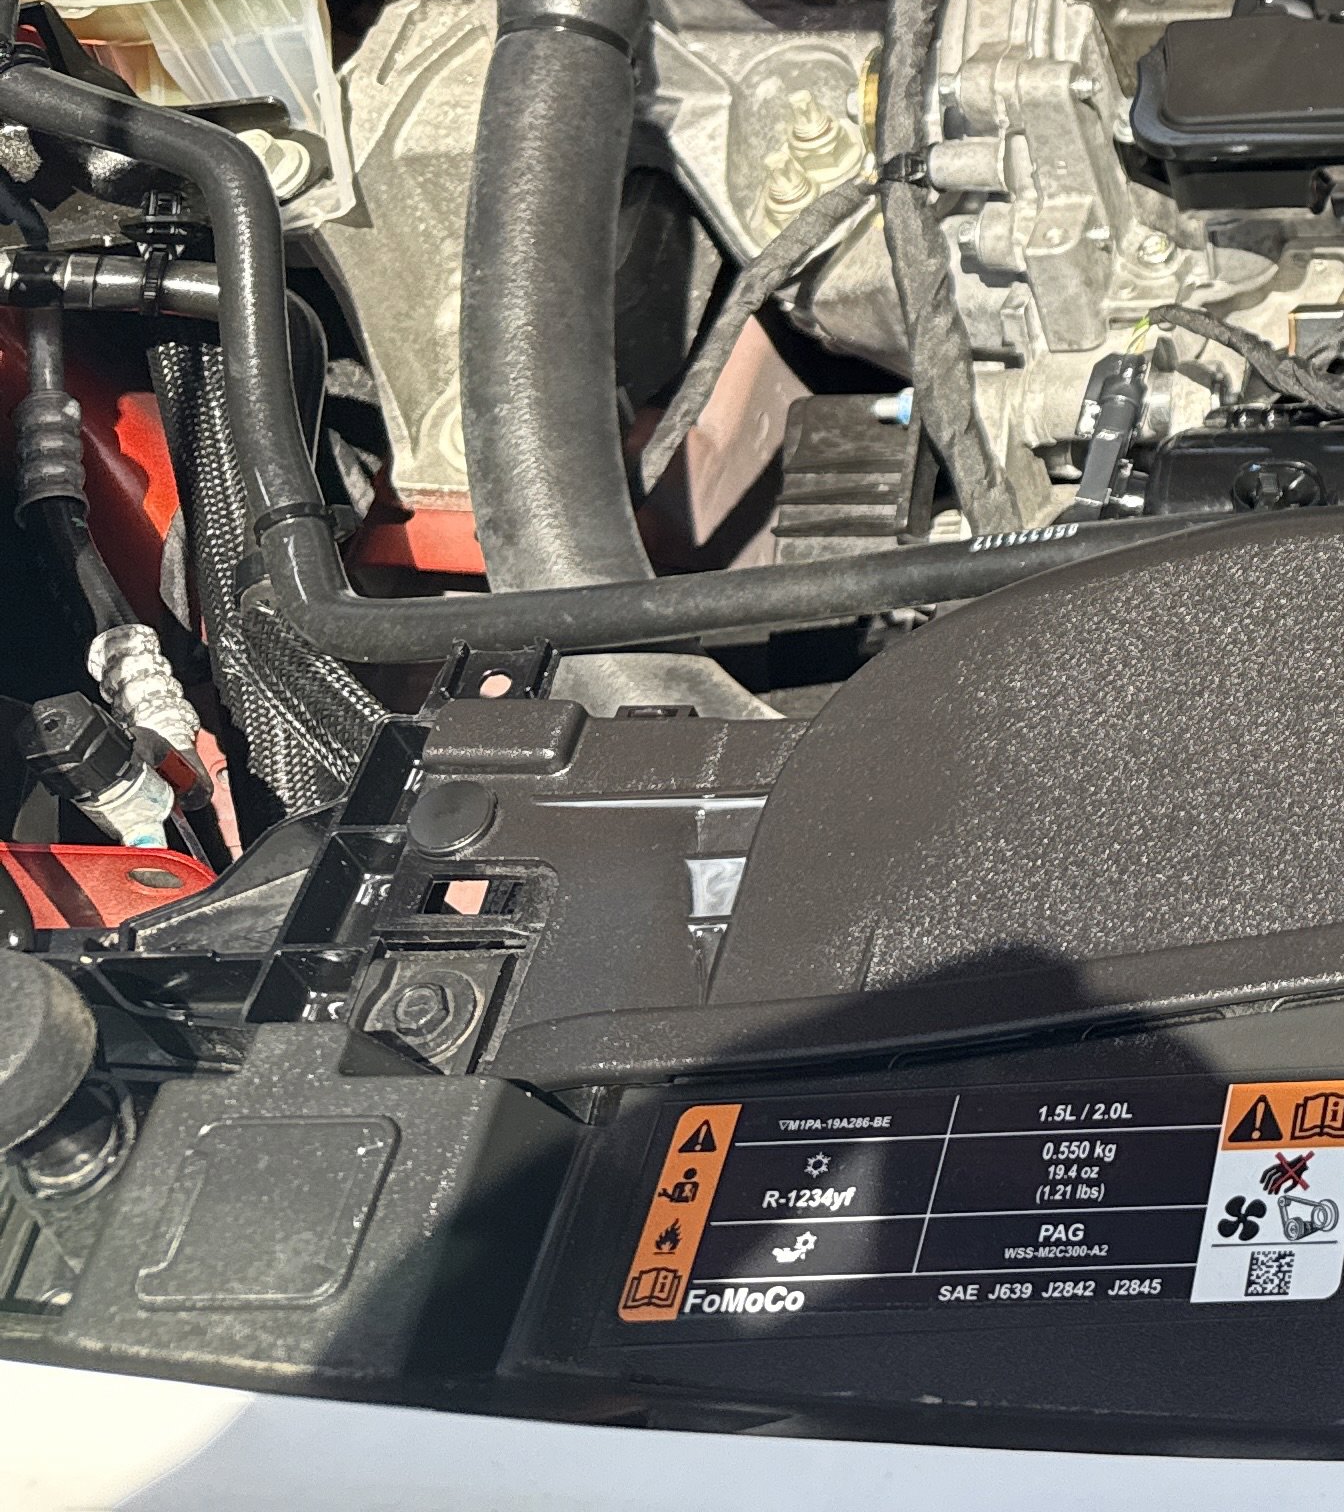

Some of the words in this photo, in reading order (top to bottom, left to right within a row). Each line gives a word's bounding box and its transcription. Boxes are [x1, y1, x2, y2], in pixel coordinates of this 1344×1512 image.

[1037, 1103, 1077, 1123] 1.5L
[1079, 1102, 1091, 1121] /
[1091, 1101, 1133, 1120] 2.0L
[1041, 1140, 1091, 1161] 0.550
[1092, 1139, 1118, 1163] kg
[1047, 1163, 1078, 1181] 19.4
[1080, 1166, 1101, 1180] oz
[761, 1186, 857, 1212] R-1234yf
[1035, 1184, 1072, 1205] (1.21
[1075, 1182, 1106, 1203] lbs)
[1037, 1222, 1086, 1243] PAG
[1003, 1244, 1110, 1260] WSS-M2C300-A2
[683, 1285, 806, 1314] FoMoCo
[937, 1284, 980, 1302] SAE
[987, 1283, 1033, 1300] J639
[1041, 1280, 1096, 1298] J2842
[1107, 1278, 1162, 1296] J2845
